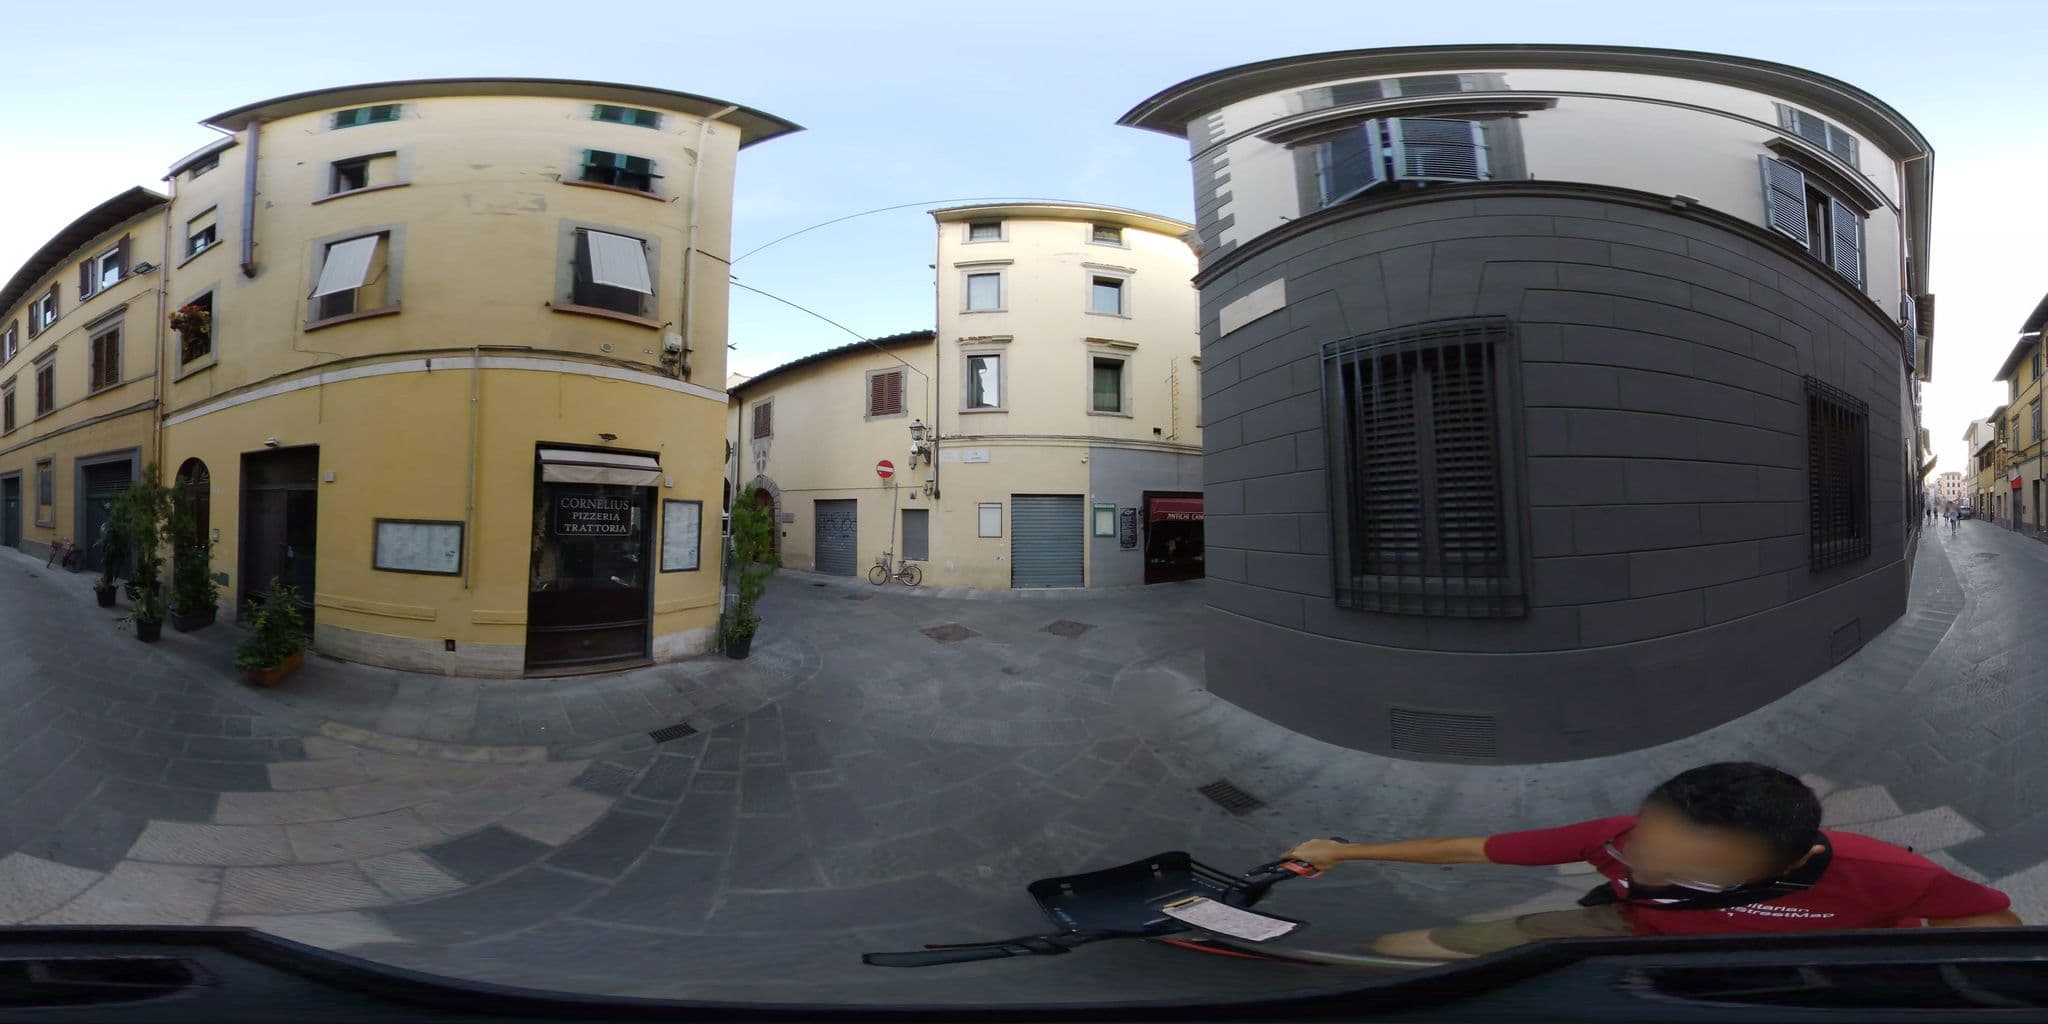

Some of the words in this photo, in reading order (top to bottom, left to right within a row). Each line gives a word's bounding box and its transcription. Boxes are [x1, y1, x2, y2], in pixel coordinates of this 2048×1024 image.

[560, 497, 629, 511] CORNELIUS
[572, 512, 620, 521] PIZZERIA
[1167, 512, 1190, 520] ANTICHI
[564, 523, 626, 533] TRATTORIA
